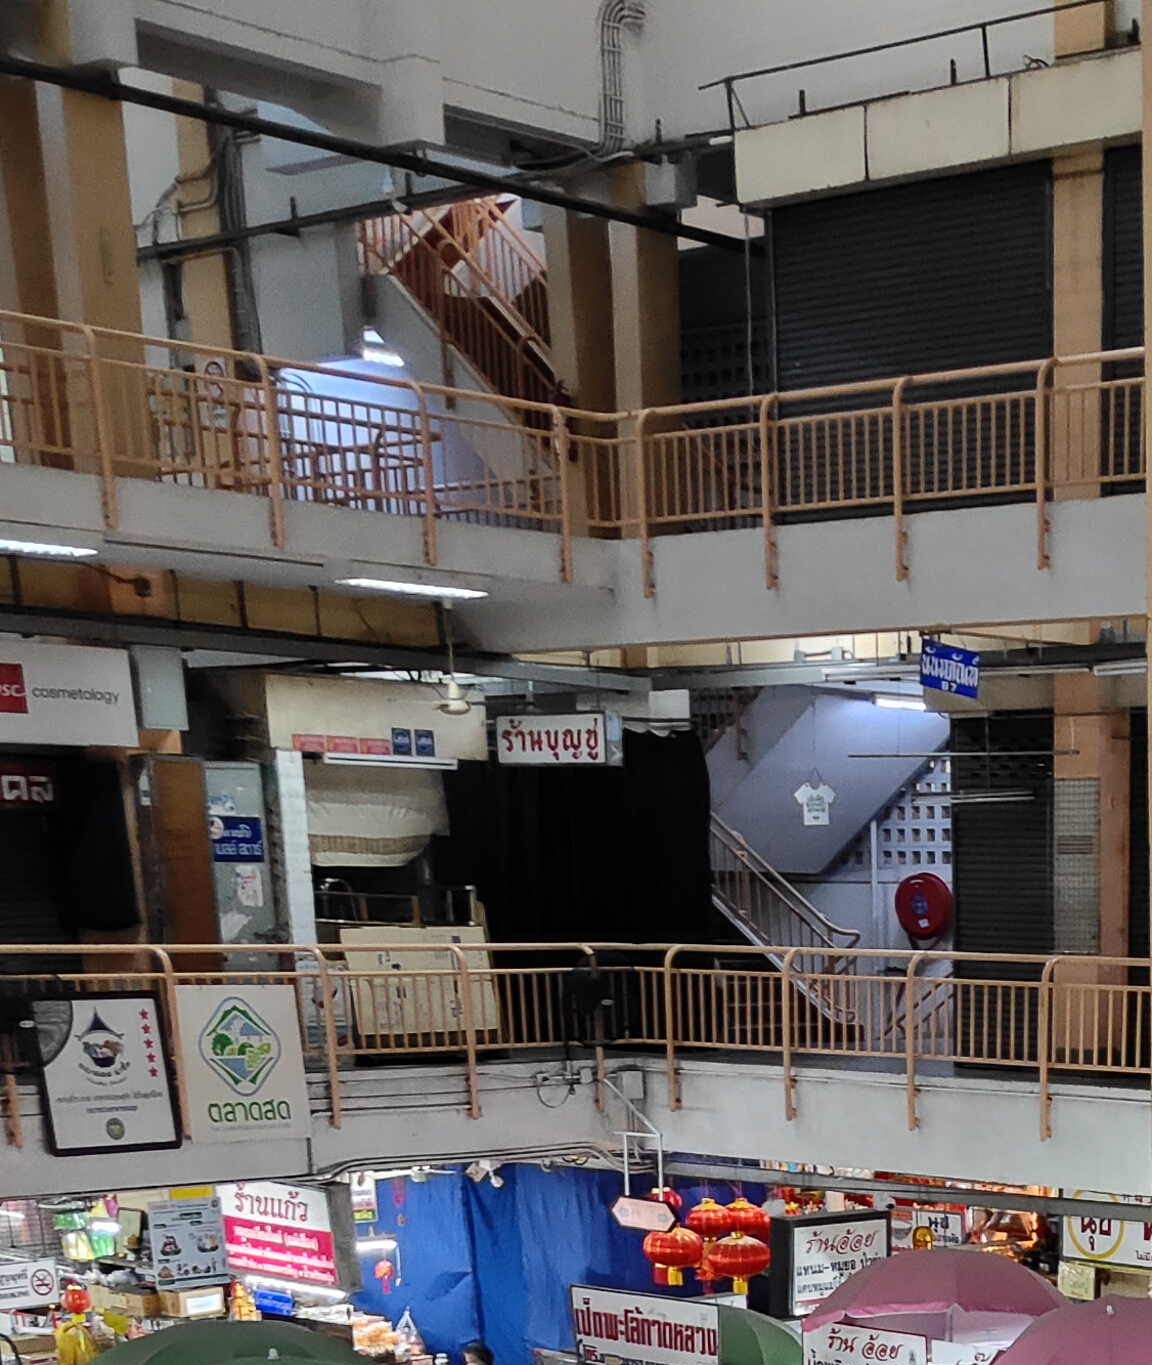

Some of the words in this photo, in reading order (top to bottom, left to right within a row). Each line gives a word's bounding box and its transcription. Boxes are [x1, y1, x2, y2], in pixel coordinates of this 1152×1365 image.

[32, 687, 120, 704] cosmetology
[502, 718, 599, 761] ร้านบุญชู
[208, 1099, 291, 1123] ตลาดสด
[235, 1182, 308, 1222] ร้านแก้ว
[806, 1229, 879, 1255] ร้านอ้อย
[862, 1334, 904, 1361] อ้อย
